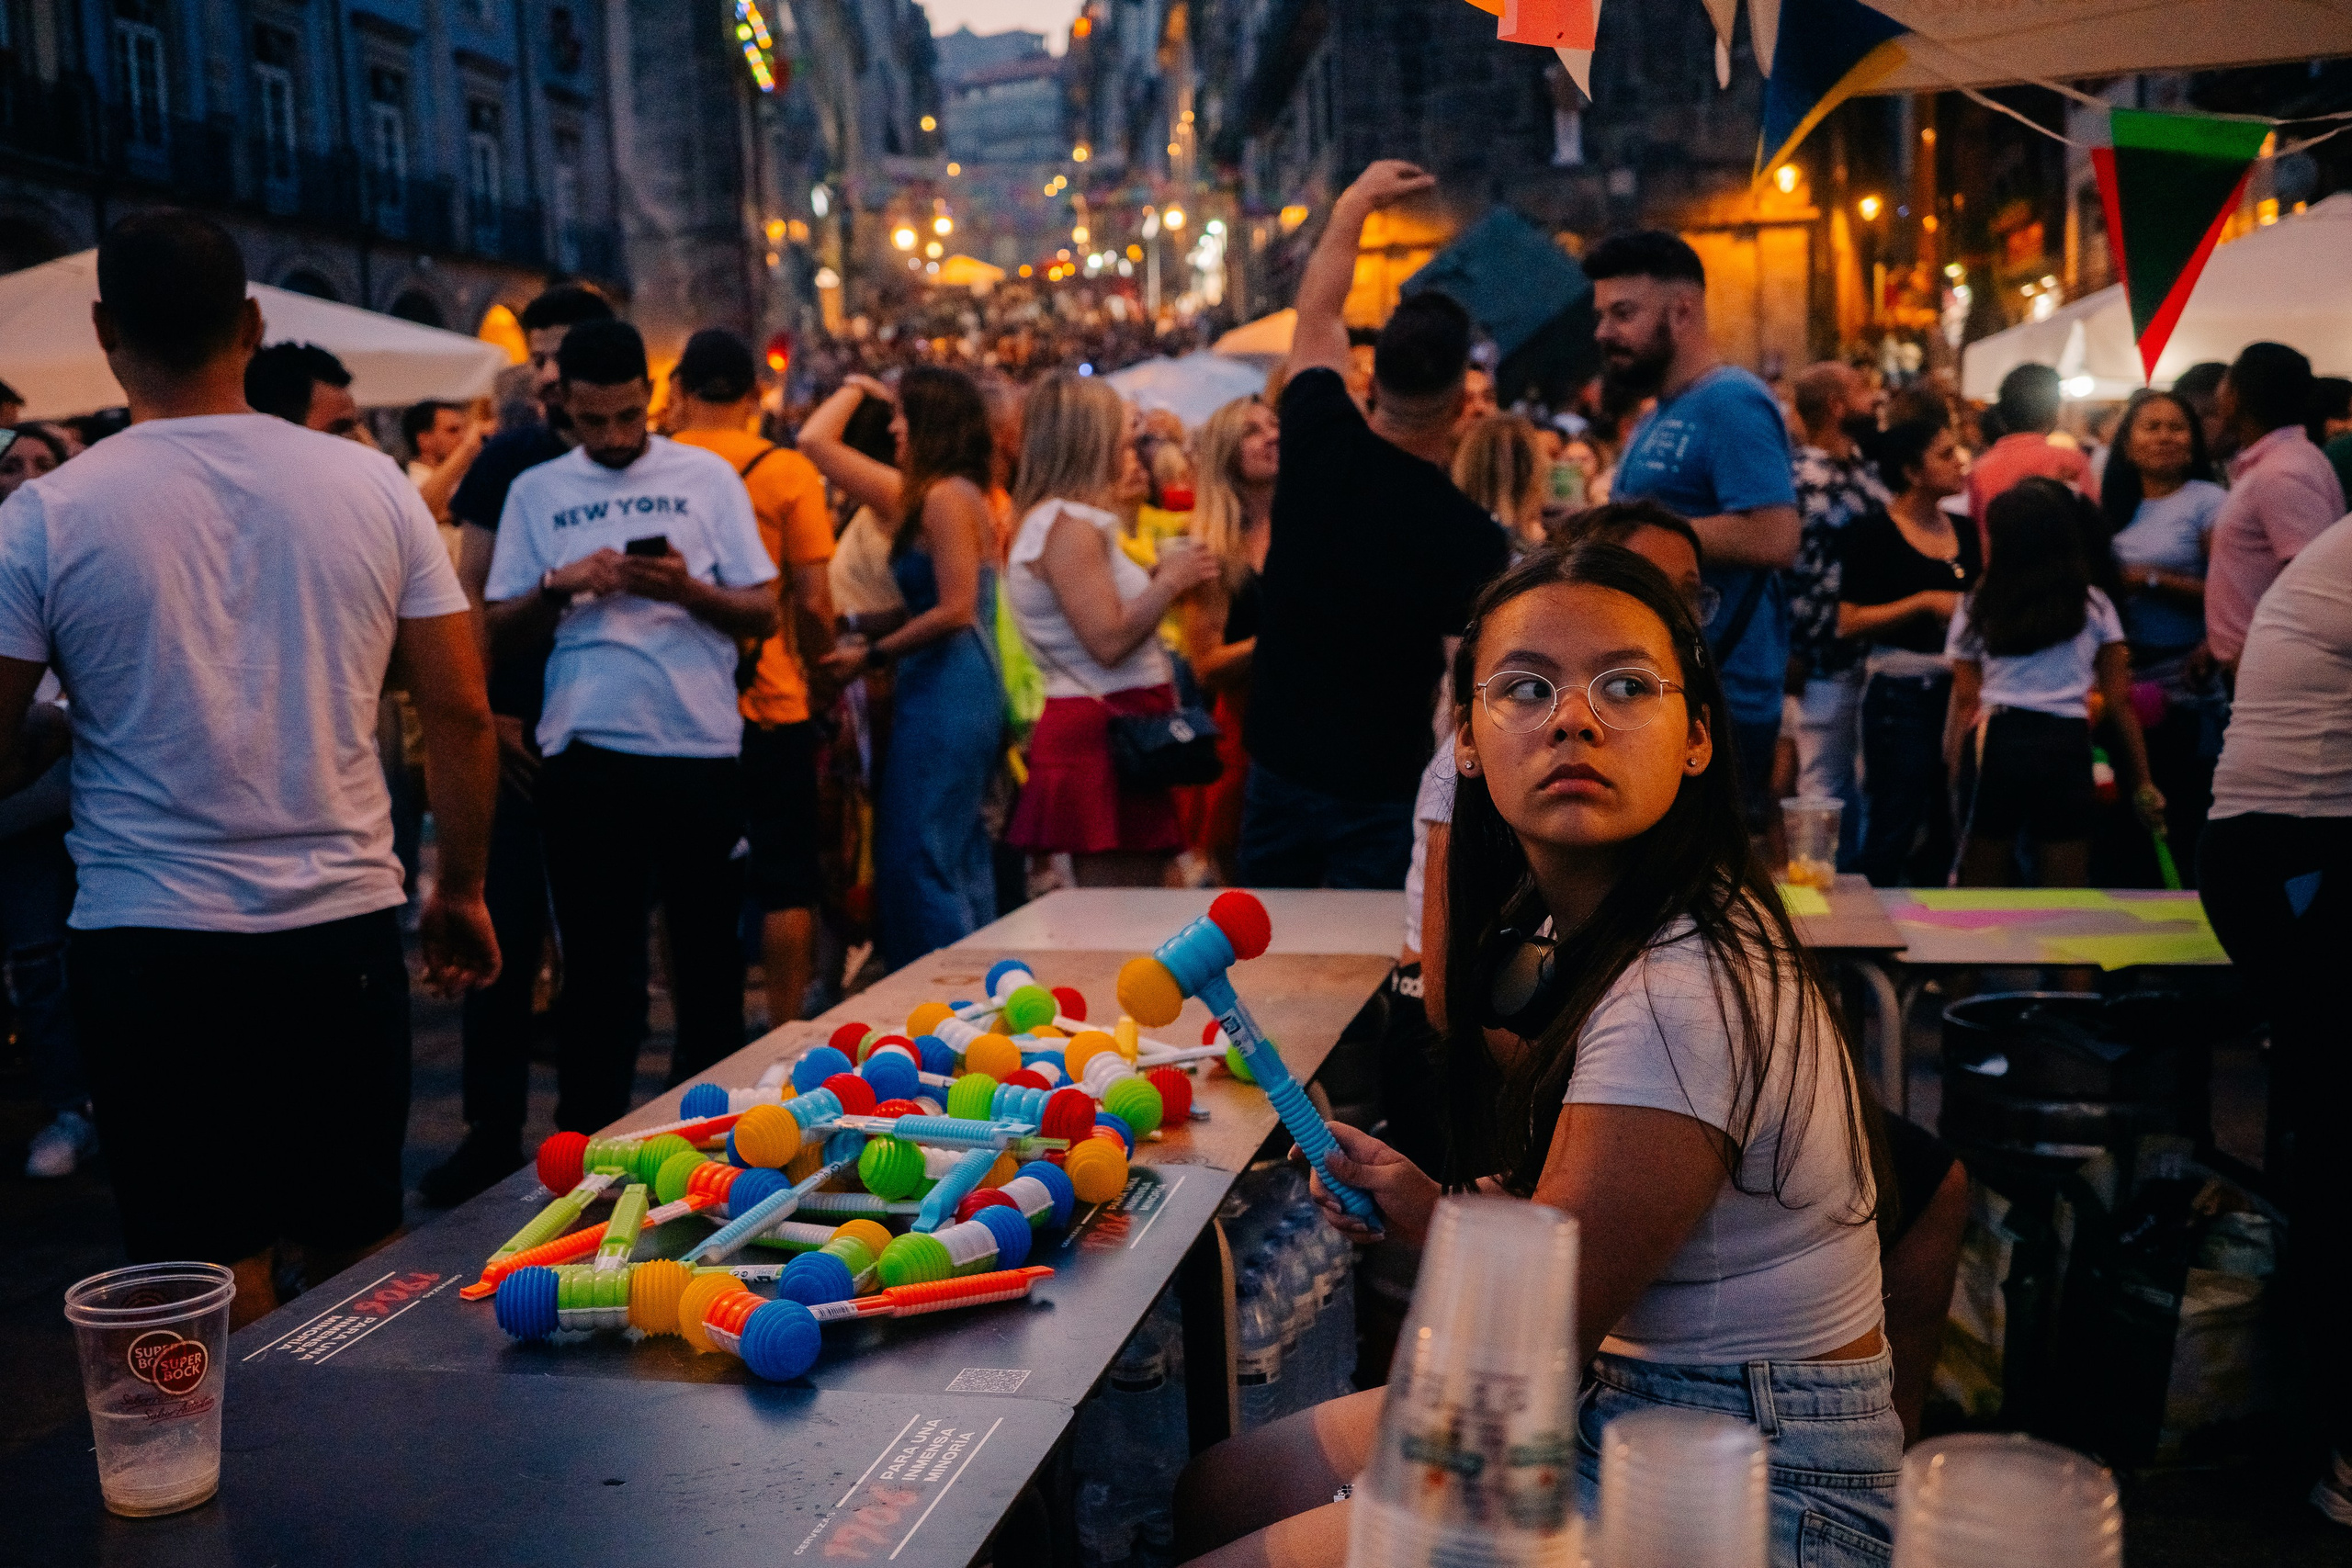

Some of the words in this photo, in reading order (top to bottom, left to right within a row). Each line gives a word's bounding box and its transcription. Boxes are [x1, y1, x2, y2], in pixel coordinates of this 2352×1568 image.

[553, 501, 609, 530] NEW
[616, 496, 688, 516] YORK
[290, 1316, 360, 1355] INMENSA
[332, 1316, 378, 1340] PARA
[135, 1345, 169, 1358] SUP
[160, 1352, 202, 1371] SUPER
[298, 1342, 337, 1360] UNA
[164, 1363, 200, 1382] BOCK
[143, 1406, 175, 1420] Sabor
[879, 1446, 919, 1480] PARA
[910, 1419, 943, 1443] UNA
[901, 1427, 956, 1481] INMENSA
[794, 1512, 835, 1555] CERVEZAS
